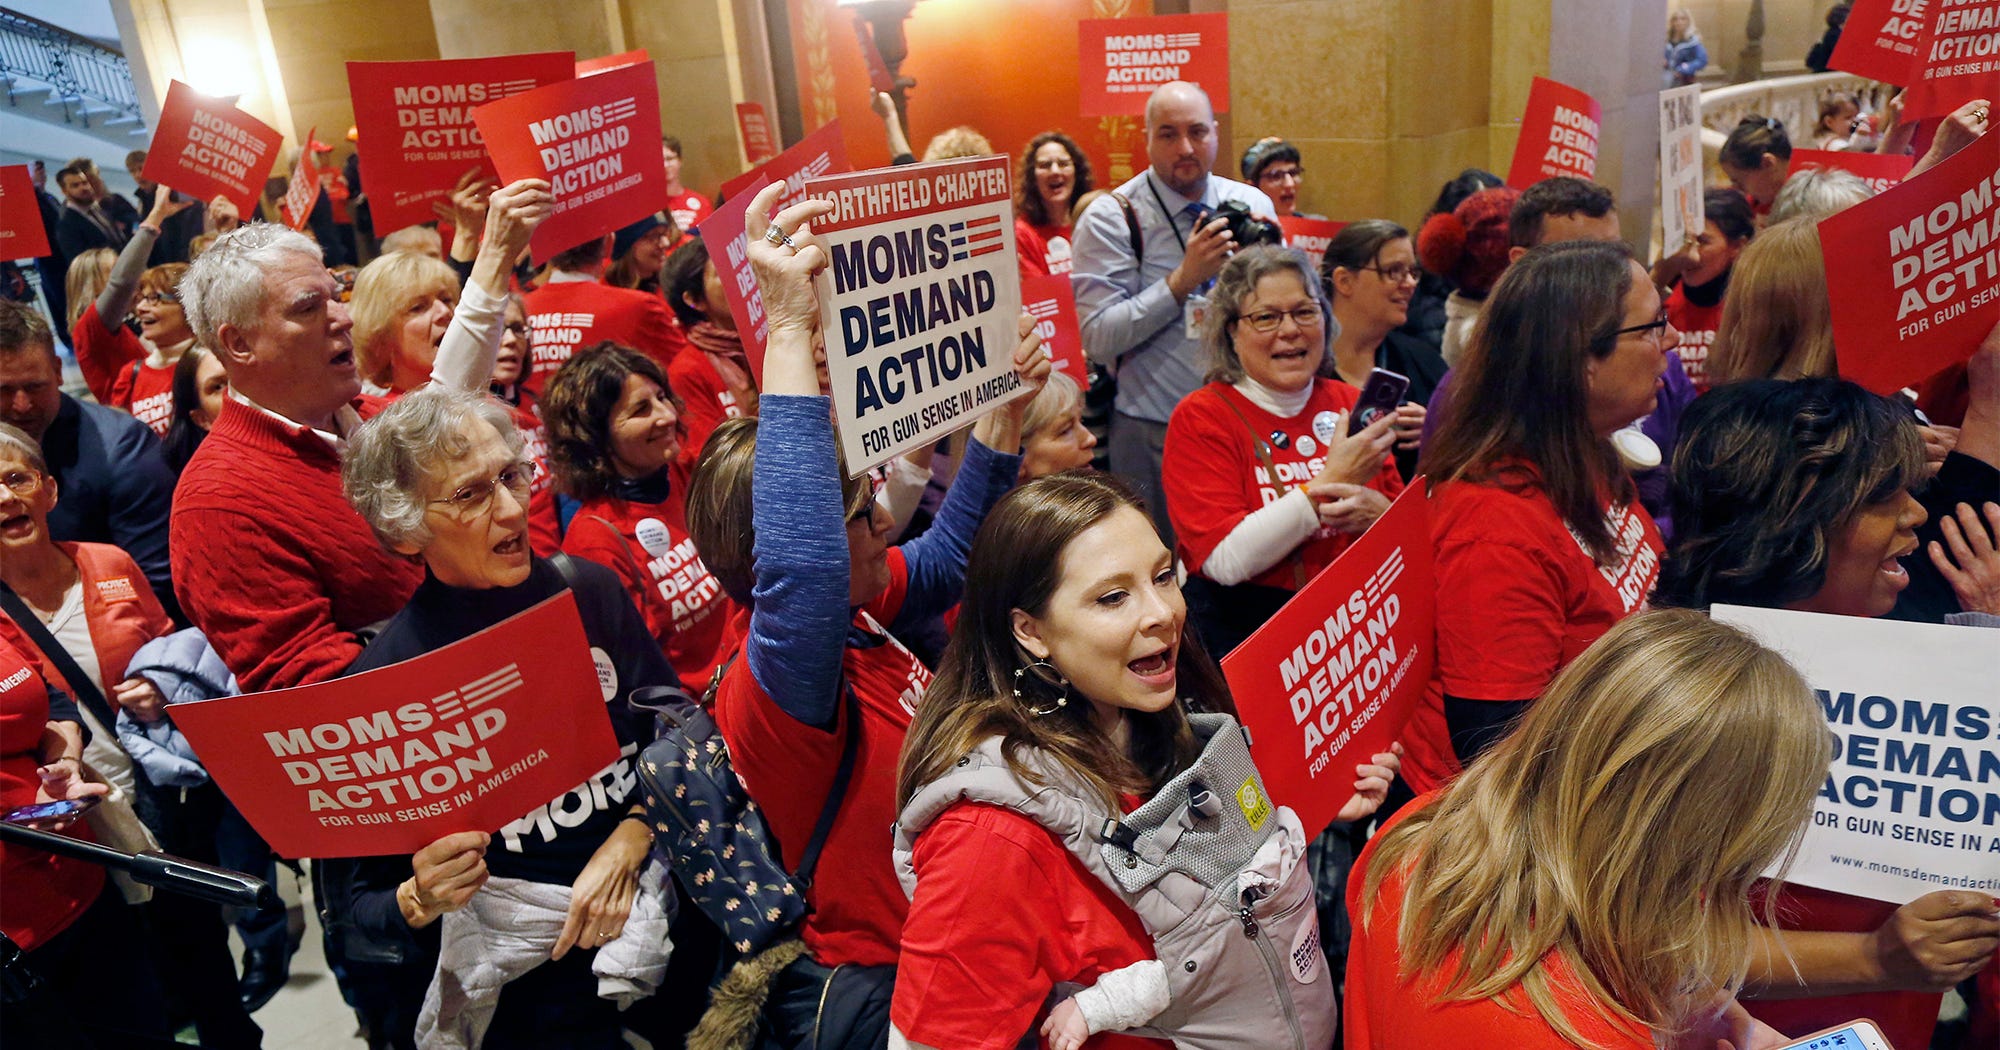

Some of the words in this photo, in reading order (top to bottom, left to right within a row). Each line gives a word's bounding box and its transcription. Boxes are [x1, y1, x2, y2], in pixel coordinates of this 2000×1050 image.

[1105, 34, 1166, 51] MOMS
[1105, 49, 1191, 67] DEMAND
[1106, 66, 1180, 83] ACTION
[1953, 62, 1980, 75] SENSE
[394, 83, 486, 106] MOMS
[187, 125, 257, 168] DEMAND
[193, 109, 248, 144] MOMS
[402, 128, 486, 148] ACTIO
[528, 105, 604, 146] MOMS
[181, 143, 248, 180] ACTION
[404, 152, 424, 161] FOR
[540, 125, 630, 172] DEMAND
[551, 153, 623, 200] ACTION
[935, 167, 1007, 202] CHAPTER
[831, 223, 952, 296] MOMS
[527, 312, 562, 328] OMS
[840, 269, 996, 358] DEMAND
[1899, 318, 1930, 341] FOR
[1934, 301, 1966, 325] GUN
[533, 328, 582, 345] MAND
[855, 326, 988, 419] ACTION
[861, 427, 890, 457] FOR
[892, 417, 921, 443] GUN
[922, 400, 960, 430] SENSE
[961, 392, 973, 412] IN
[976, 369, 1021, 406] AMERICA
[647, 537, 698, 580] MOM
[1617, 540, 1658, 613] ACTION
[1279, 588, 1369, 692] MOMS
[1289, 592, 1401, 726] DEMAND
[1304, 636, 1398, 760] ACTION
[1309, 750, 1330, 780] FOR
[1330, 728, 1351, 757] GUN
[1351, 697, 1382, 735] SENSE
[1380, 685, 1390, 704] IN
[1389, 643, 1419, 693] AMERICA
[1814, 689, 1991, 741] MOMS
[263, 702, 433, 757] MOMS
[282, 707, 508, 786] DEMAND
[309, 746, 495, 811] ACTION
[318, 815, 353, 827] FOR
[356, 809, 394, 825] GUN
[397, 798, 453, 822] SENSE
[455, 790, 473, 808] IN
[477, 748, 550, 798] AMERICA
[1815, 810, 1839, 829] OR
[1846, 816, 1885, 837] GUN
[1891, 824, 1955, 848] SENSE
[1961, 834, 1982, 851] IN
[1831, 854, 2000, 890] www.momsdemandacti
